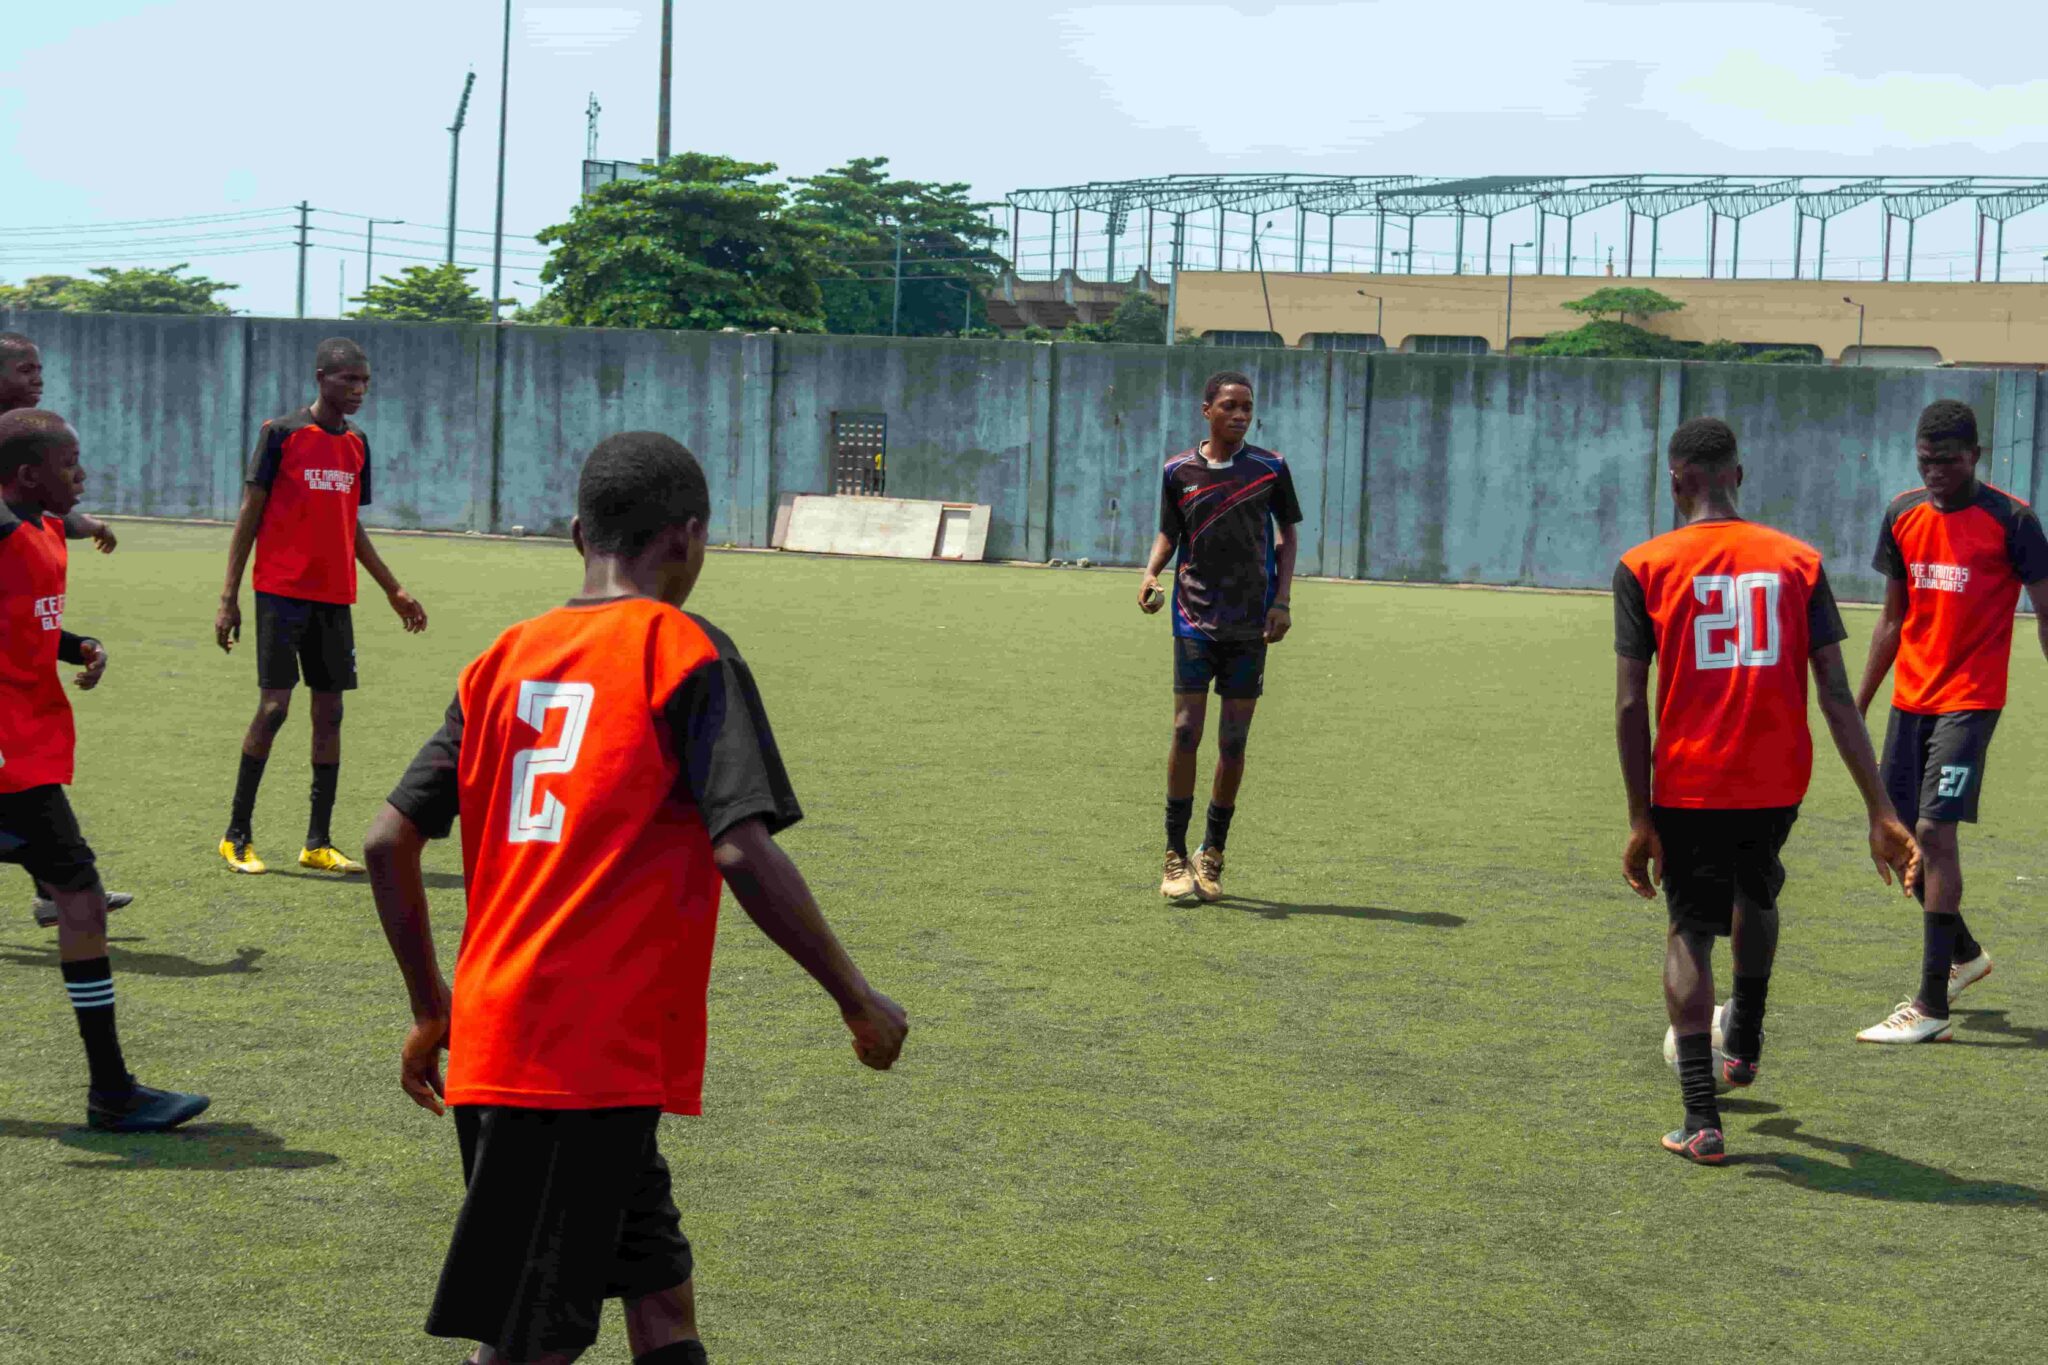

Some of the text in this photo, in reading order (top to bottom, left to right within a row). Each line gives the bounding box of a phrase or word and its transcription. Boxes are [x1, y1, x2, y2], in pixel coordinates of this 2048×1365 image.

[304, 469, 321, 481] ACE
[34, 596, 59, 617] ACE
[1692, 571, 1780, 670] 20
[508, 680, 595, 842] 2
[1937, 765, 1969, 798] 27
